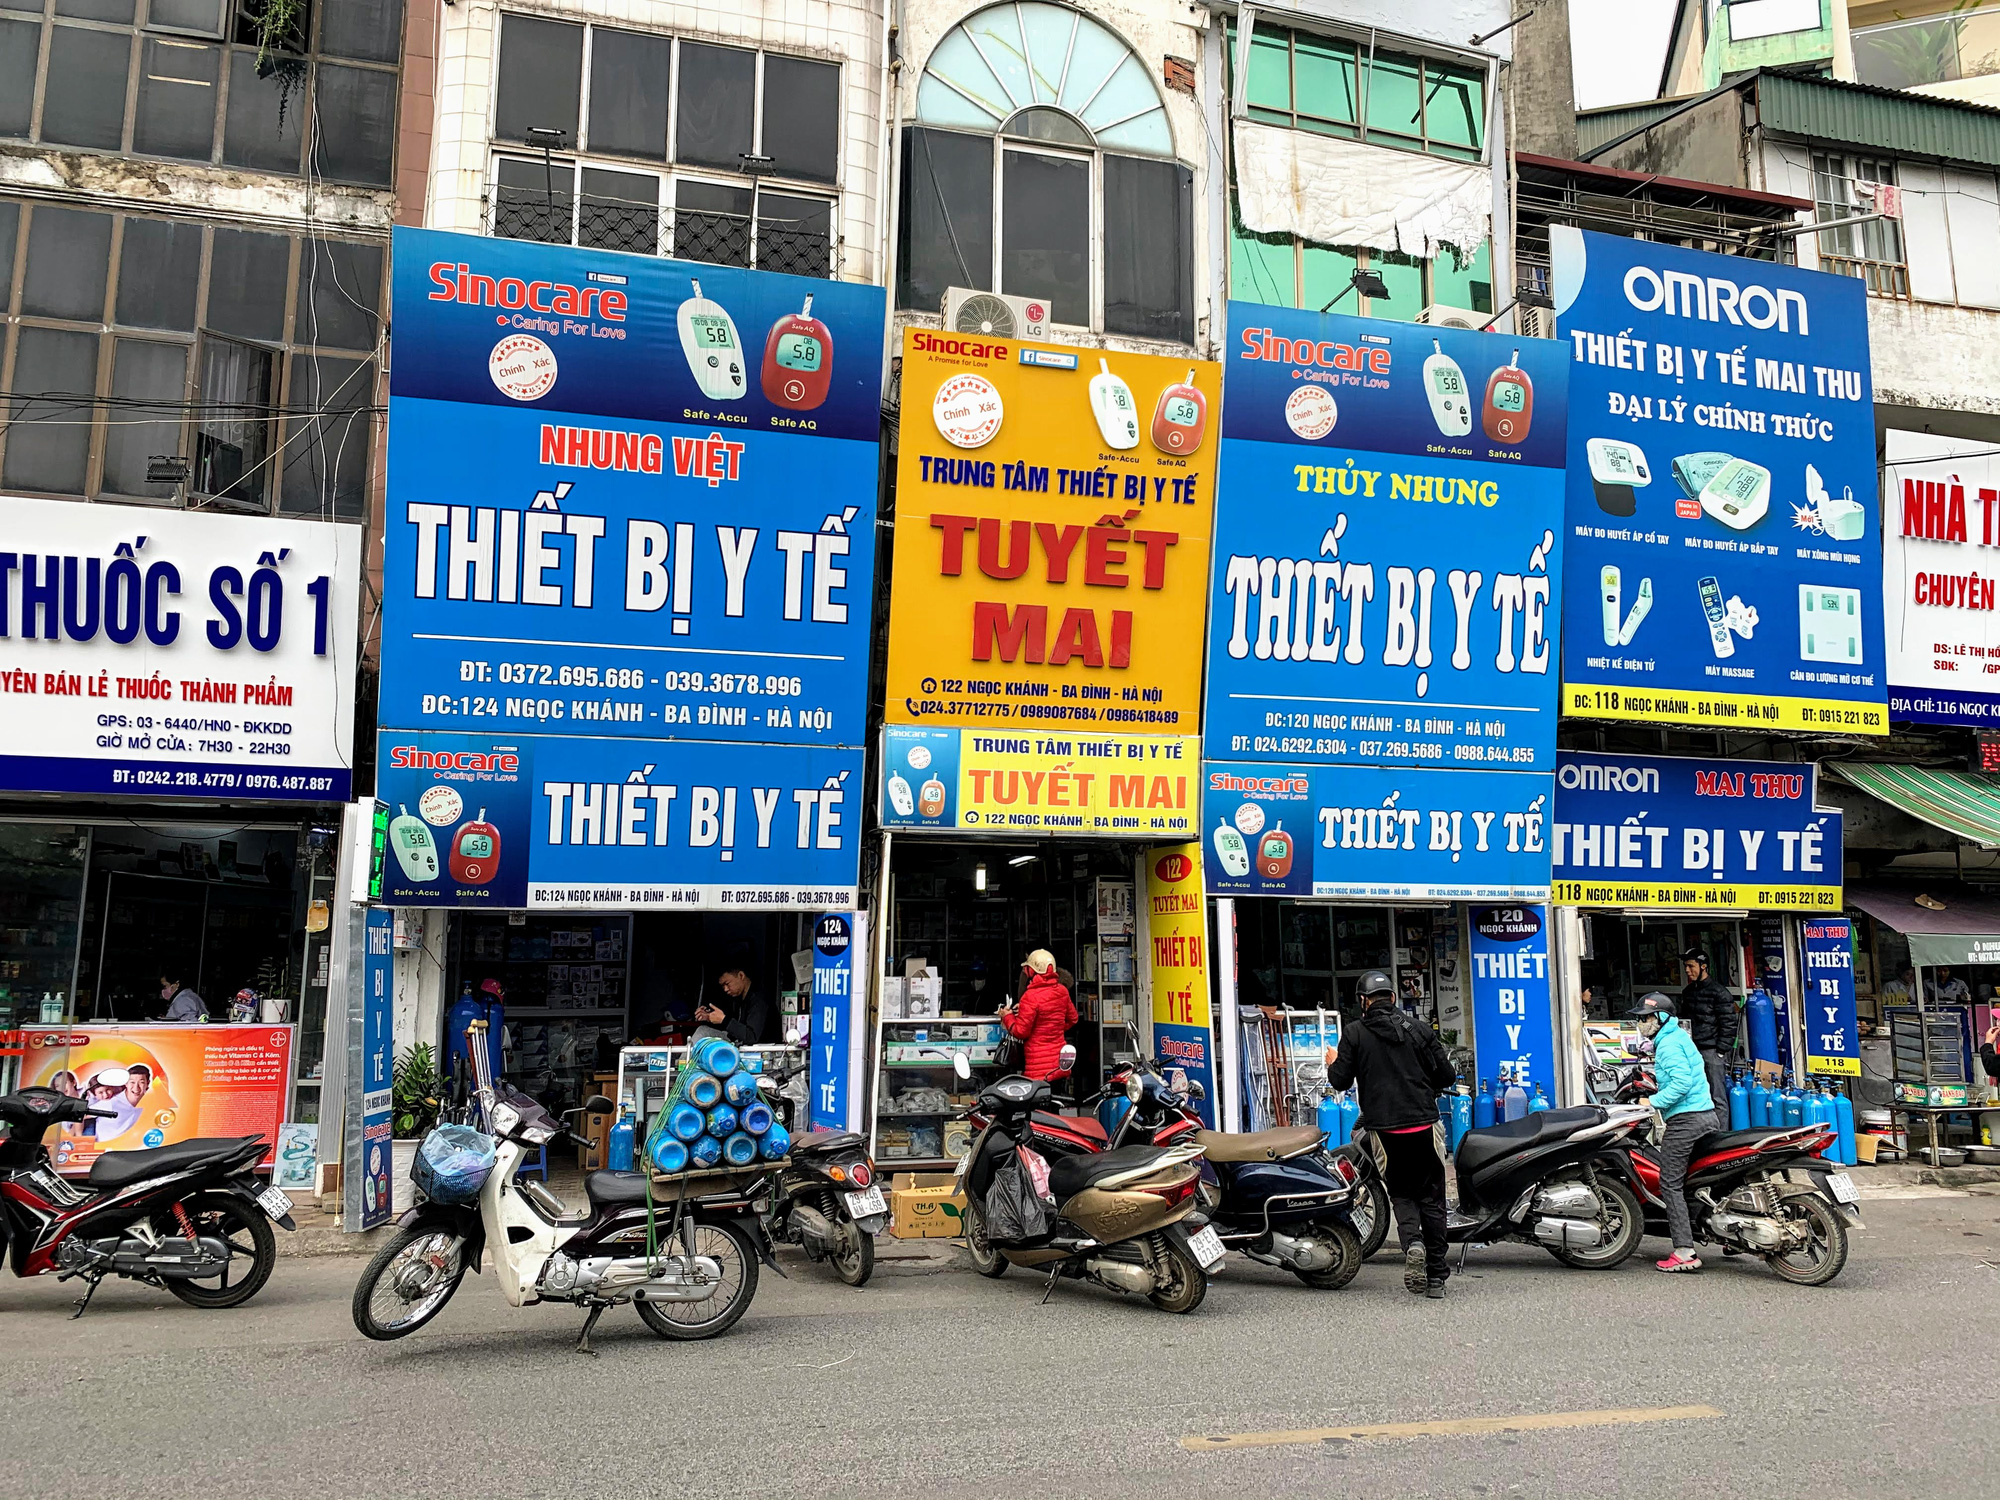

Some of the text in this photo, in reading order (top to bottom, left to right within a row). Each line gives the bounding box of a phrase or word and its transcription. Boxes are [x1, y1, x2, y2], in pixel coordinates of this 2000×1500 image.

[428, 262, 628, 322] Sinocare
[1623, 265, 1809, 336] OMRON
[512, 314, 627, 341] Caring For Love
[1027, 325, 1041, 336] LG
[912, 332, 1008, 361] Sinocare
[1241, 327, 1391, 374] Sinocare
[498, 356, 551, 379] Chính Xác
[934, 357, 960, 370] Promise
[961, 360, 971, 368] for
[1571, 327, 1862, 402] THIẾT BỊ Y TẾ MAI THU
[683, 409, 711, 421] Safe
[770, 416, 817, 431] Safe AQ
[1608, 391, 1834, 443] ĐẠI LÝ CHÍNH THỨC
[539, 423, 745, 487] NHUNG VIỆT
[919, 455, 1199, 506] TRUNG TÂM THIẾT BỊ Y TẾ
[1293, 458, 1499, 508] THỦY NHUNG
[1903, 474, 2000, 548] NHÀ T
[1575, 525, 1669, 545] MÁY ĐO HUYẾT ÁP CỔ TAY
[407, 482, 860, 636] THIẾT BỊ Y TẾ
[929, 509, 1179, 590] TUYẾT
[0, 536, 331, 656] THUỐC SỐ 1
[1914, 571, 1995, 611] CHUYÊN
[1225, 512, 1555, 698] THIẾT BỊ Y TẾ
[971, 601, 1133, 669] MAI
[1934, 643, 1951, 655] DS:
[1954, 643, 1966, 656] LÊ
[1969, 646, 1985, 659] THỊ
[459, 660, 802, 697] ĐT: 0372.695.686 039.3678.996
[1705, 664, 1755, 678] MÁY MASSAGE
[1934, 660, 1958, 671] SĐK:
[44, 670, 81, 696] BÁN
[88, 669, 108, 698] LẺ
[116, 671, 172, 701] THUỐC
[180, 677, 237, 705] THÀNH
[244, 675, 293, 707] PHẨM
[920, 701, 1179, 724] 024.37712775 0989087684 0986418489
[1891, 698, 1912, 713] ĐỊA
[1914, 697, 1935, 712] CHỈ:
[1936, 701, 1957, 714] 116
[1959, 702, 1989, 718] NGỌC
[97, 714, 132, 728] GPS:
[136, 716, 153, 729] 03
[243, 721, 292, 736] ĐKKDD
[888, 729, 927, 738] Sinocare
[96, 732, 122, 748] GIỜ
[128, 732, 151, 749] MỞ
[199, 740, 232, 752] 7H30
[249, 743, 291, 755] 22H30
[1231, 736, 1534, 763] ĐT: 024.6292.6304 037.269.5686 0988.644.855
[390, 745, 520, 773] Sinocare
[968, 761, 1187, 809] TUYẾT MAI
[1210, 772, 1308, 793] Sinocare
[1558, 763, 1804, 799] OMRON MAI THU
[543, 763, 850, 862] THIẾT BỊ Y TẾ
[1553, 811, 1828, 879] THIẾT BỊ Y TẾ
[1154, 889, 1198, 912] TUYẾT MAI
[823, 919, 841, 934] 124
[1480, 922, 1537, 934] NGỌC KHÁNH
[1491, 910, 1523, 922] 120
[368, 920, 391, 956] THIẾT
[1826, 927, 1848, 938] THU
[1474, 945, 1547, 978] THIẾT
[1807, 945, 1850, 968] THIẾT
[375, 969, 384, 1002] BỊ
[814, 960, 849, 996] THIẾT
[1820, 979, 1839, 999] BỊ
[376, 1011, 383, 1039] Y
[1823, 1007, 1838, 1023] Y
[1160, 1036, 1204, 1059] Sinocare
[1821, 1028, 1844, 1051] TẾ
[374, 1044, 385, 1082] TẾ
[1814, 1067, 1832, 1075] NGỌC
[1825, 1058, 1845, 1067] 118
[364, 1122, 391, 1140] Sinocare
[849, 1188, 879, 1205] 29-446
[1192, 1230, 1214, 1249] 29-E1
[1199, 1242, 1225, 1268] 473.99
